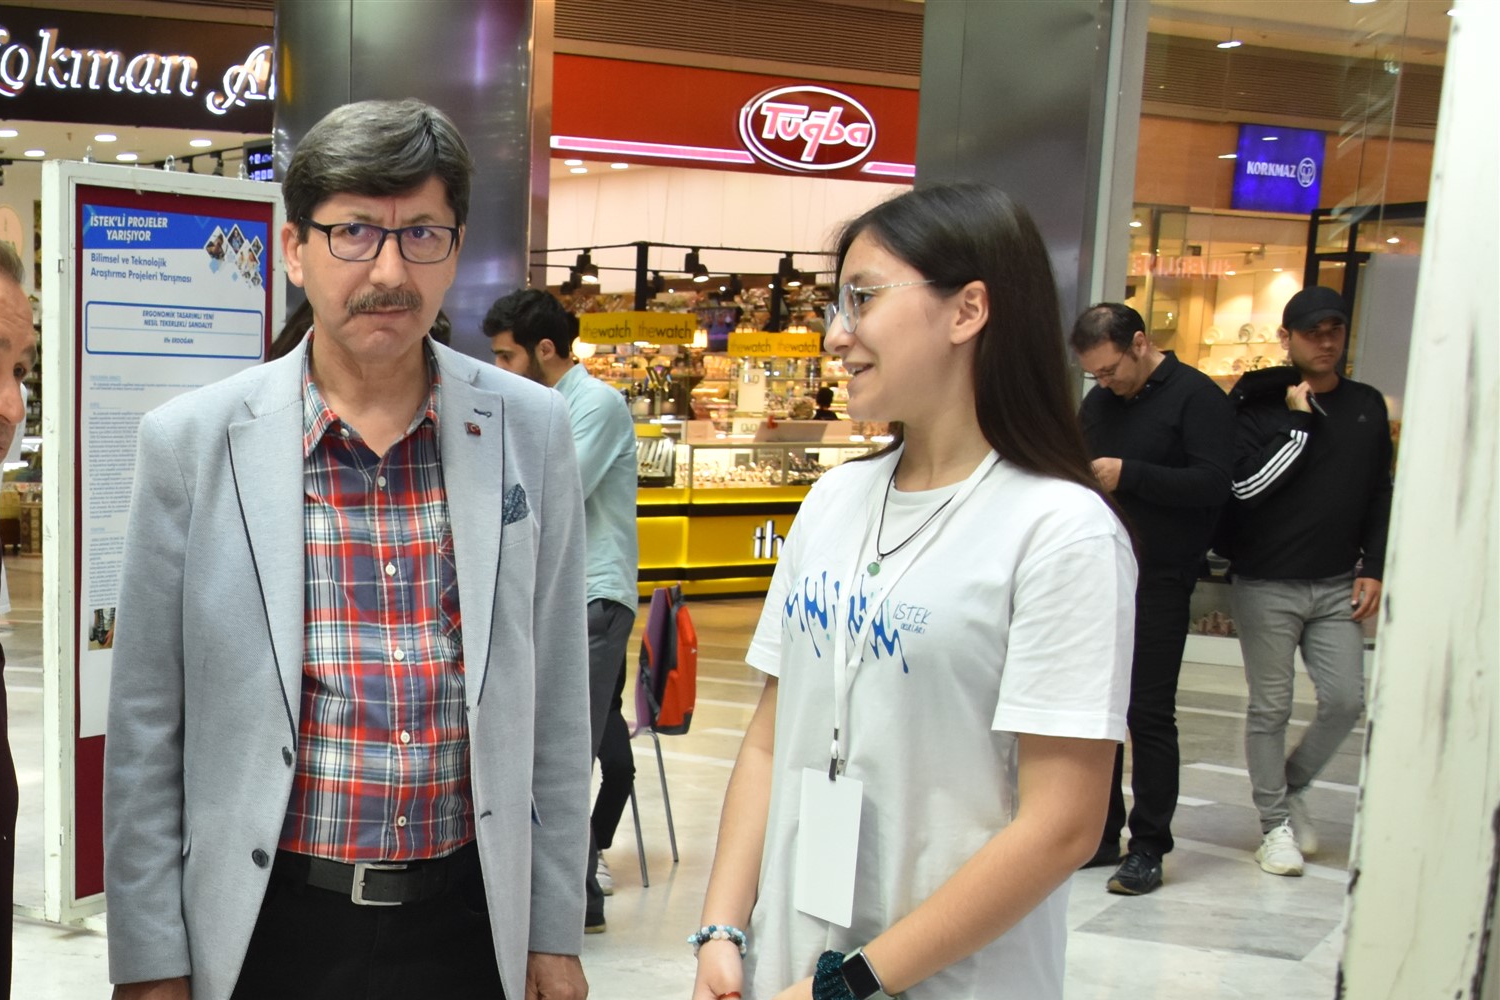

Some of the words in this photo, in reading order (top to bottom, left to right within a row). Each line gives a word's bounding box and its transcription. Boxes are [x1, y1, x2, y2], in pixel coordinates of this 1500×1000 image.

[206, 45, 274, 115] A
[1246, 160, 1297, 178] KORKMAZ
[127, 216, 168, 228] PROJELER
[106, 229, 152, 244] YARIŞIYOR
[90, 252, 120, 264] Bilimsel
[121, 257, 129, 265] ve
[131, 255, 167, 269] Teknolojik
[90, 267, 126, 280] Araştırma
[128, 270, 158, 282] Projeleri
[159, 272, 192, 285] Yarışması
[583, 324, 631, 339] thewatch
[638, 323, 692, 339] thewatch
